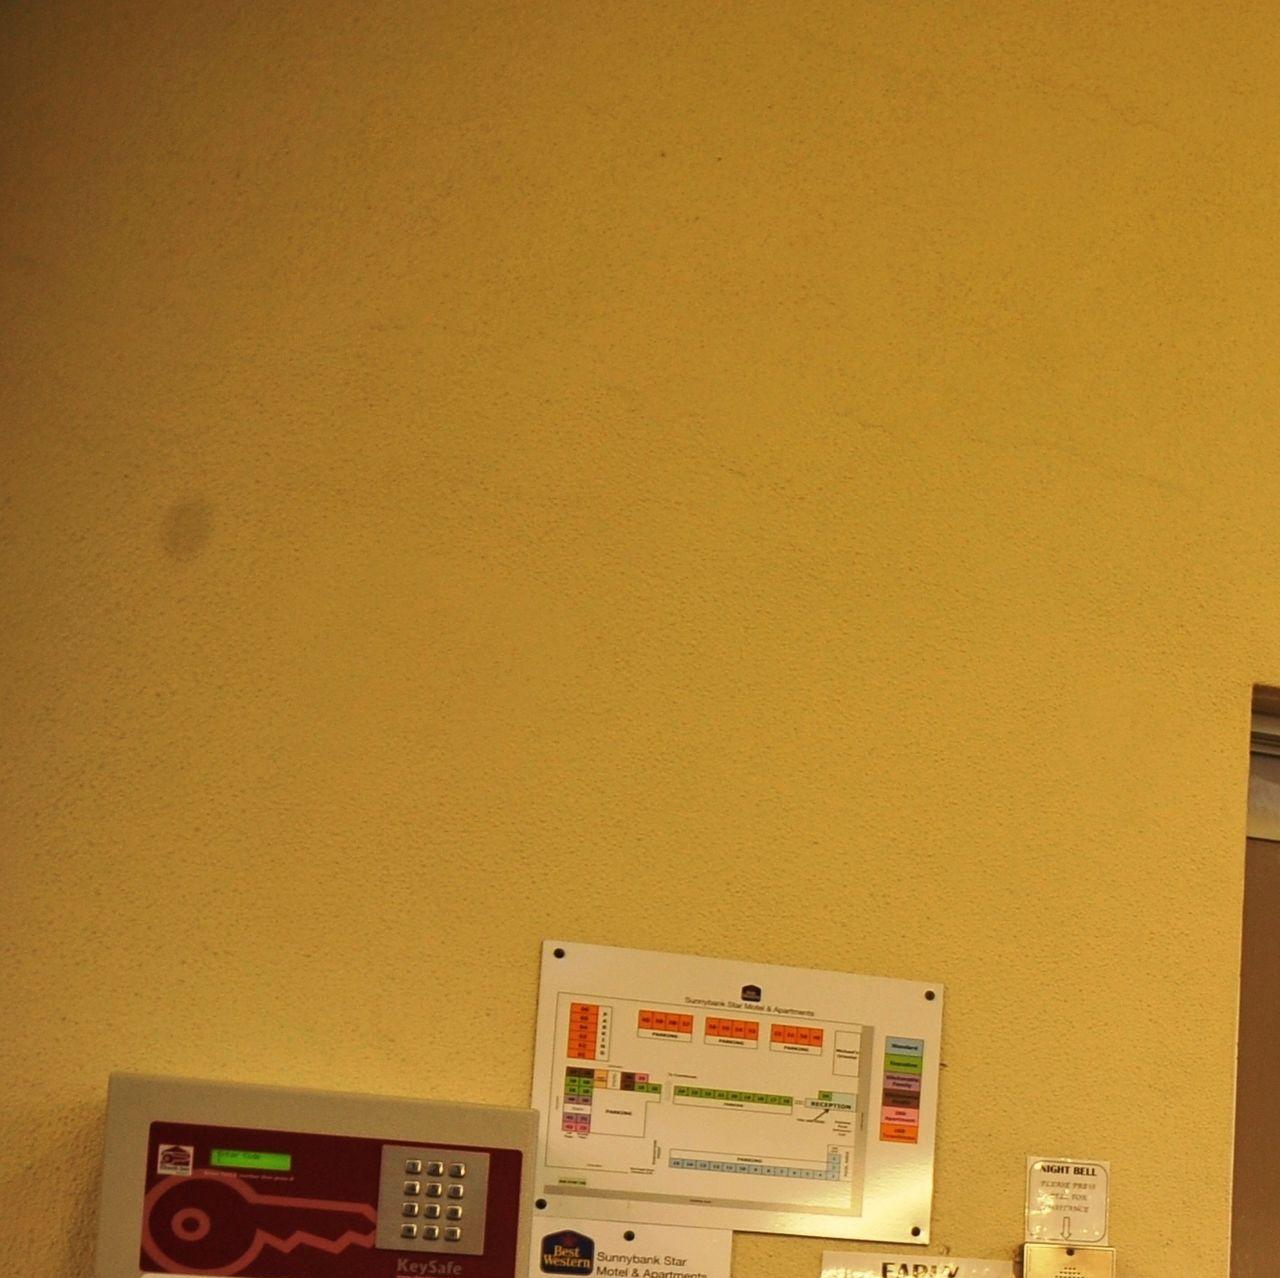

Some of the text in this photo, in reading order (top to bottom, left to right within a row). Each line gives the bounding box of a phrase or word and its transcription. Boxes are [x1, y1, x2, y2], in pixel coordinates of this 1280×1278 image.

[1041, 1165, 1097, 1177] NIGHT BELL
[553, 1245, 580, 1258] Best
[543, 1253, 591, 1269] Western
[597, 1251, 687, 1267] Sunnybank Star
[397, 1258, 463, 1276] KeySafe
[596, 1266, 628, 1278] Motel
[632, 1268, 640, 1278] &
